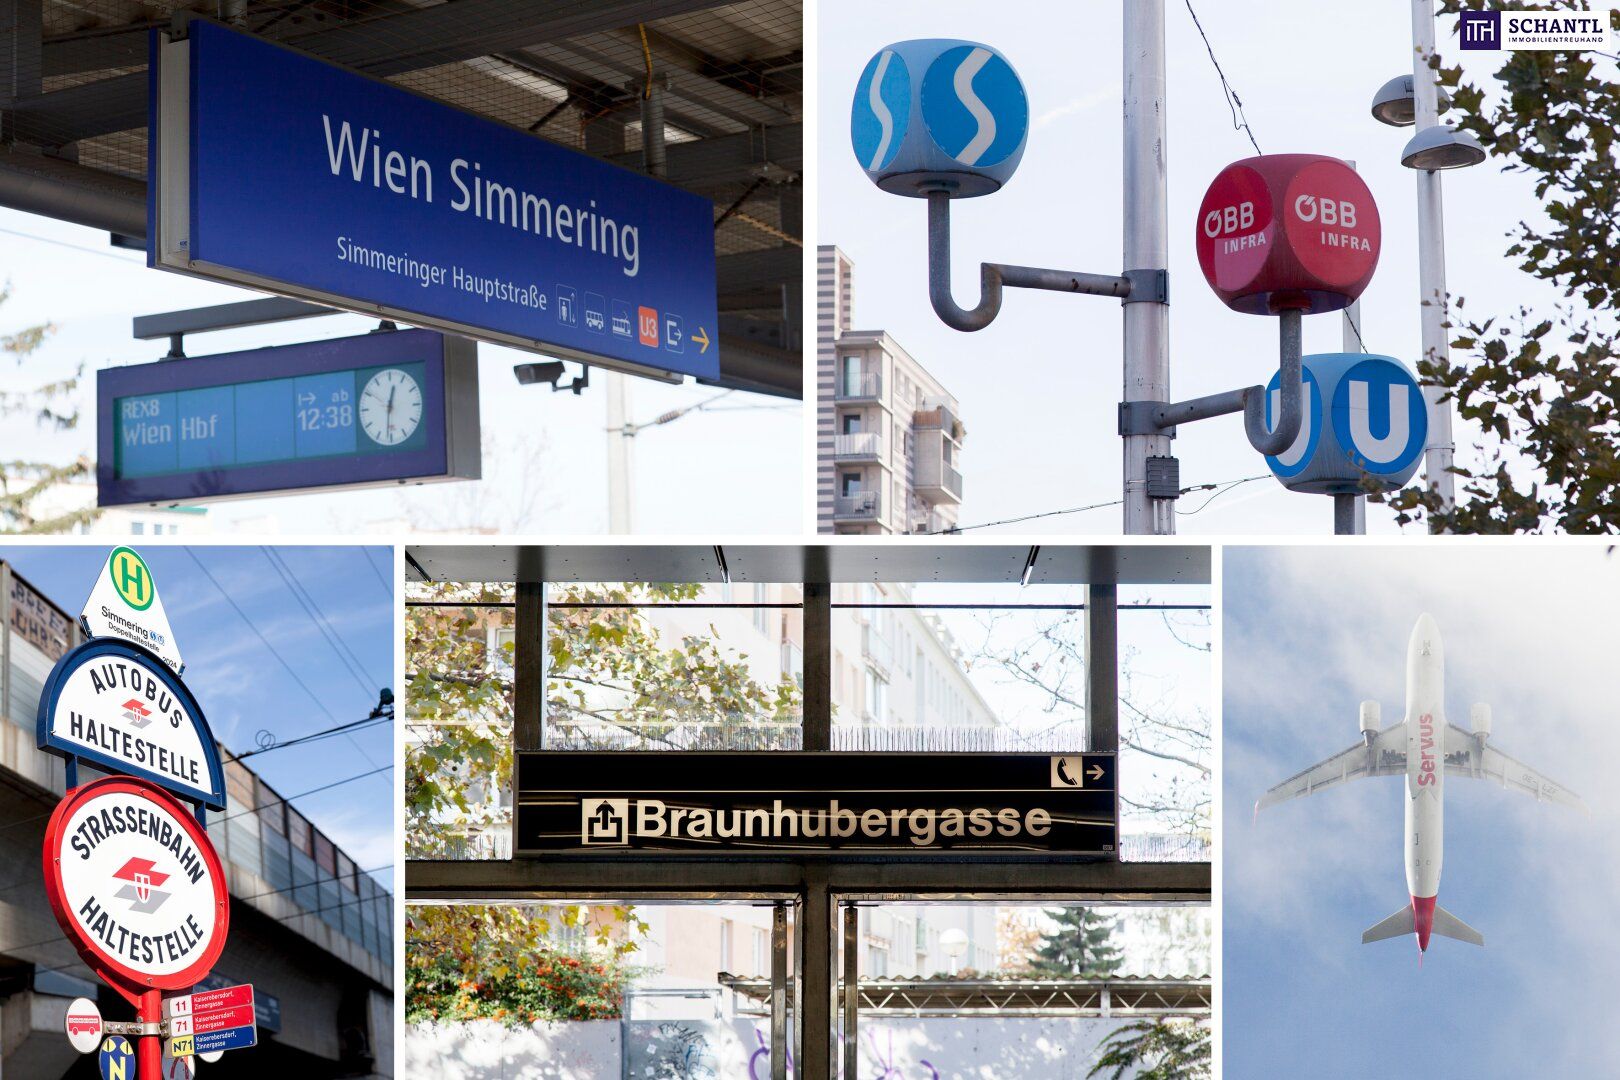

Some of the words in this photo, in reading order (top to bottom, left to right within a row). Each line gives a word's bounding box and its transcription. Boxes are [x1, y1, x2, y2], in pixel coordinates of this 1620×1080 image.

[322, 114, 433, 203] Wien
[450, 158, 640, 278] Simmering
[1295, 194, 1357, 229] ÖBB
[1204, 201, 1255, 238] ÖBB
[1223, 232, 1267, 255] INFRA
[1321, 231, 1371, 253] INFRA
[336, 236, 447, 289] Simmeringer
[452, 265, 548, 312] Hauptstraße
[640, 314, 658, 339] U3
[122, 399, 160, 419] REX8
[331, 389, 349, 403] ab
[122, 422, 172, 447] Wien
[181, 414, 218, 440] Hbf
[298, 404, 352, 431] 12:38
[1348, 379, 1410, 464] U
[121, 556, 144, 602] H
[101, 605, 149, 640] Simmering
[108, 622, 160, 653] Doppelhaltestelle
[90, 663, 183, 729] AUTOBUS
[70, 711, 200, 784] HALTESTELLE
[1418, 713, 1436, 787] Servus
[636, 799, 1052, 846] Braunhubergasse
[71, 806, 205, 885] STRASSENBAHN
[79, 896, 204, 964] HALTESTELLE
[175, 1001, 187, 1012] 11
[176, 1021, 188, 1033] 71
[173, 1039, 193, 1052] N71
[109, 1055, 126, 1080] N
